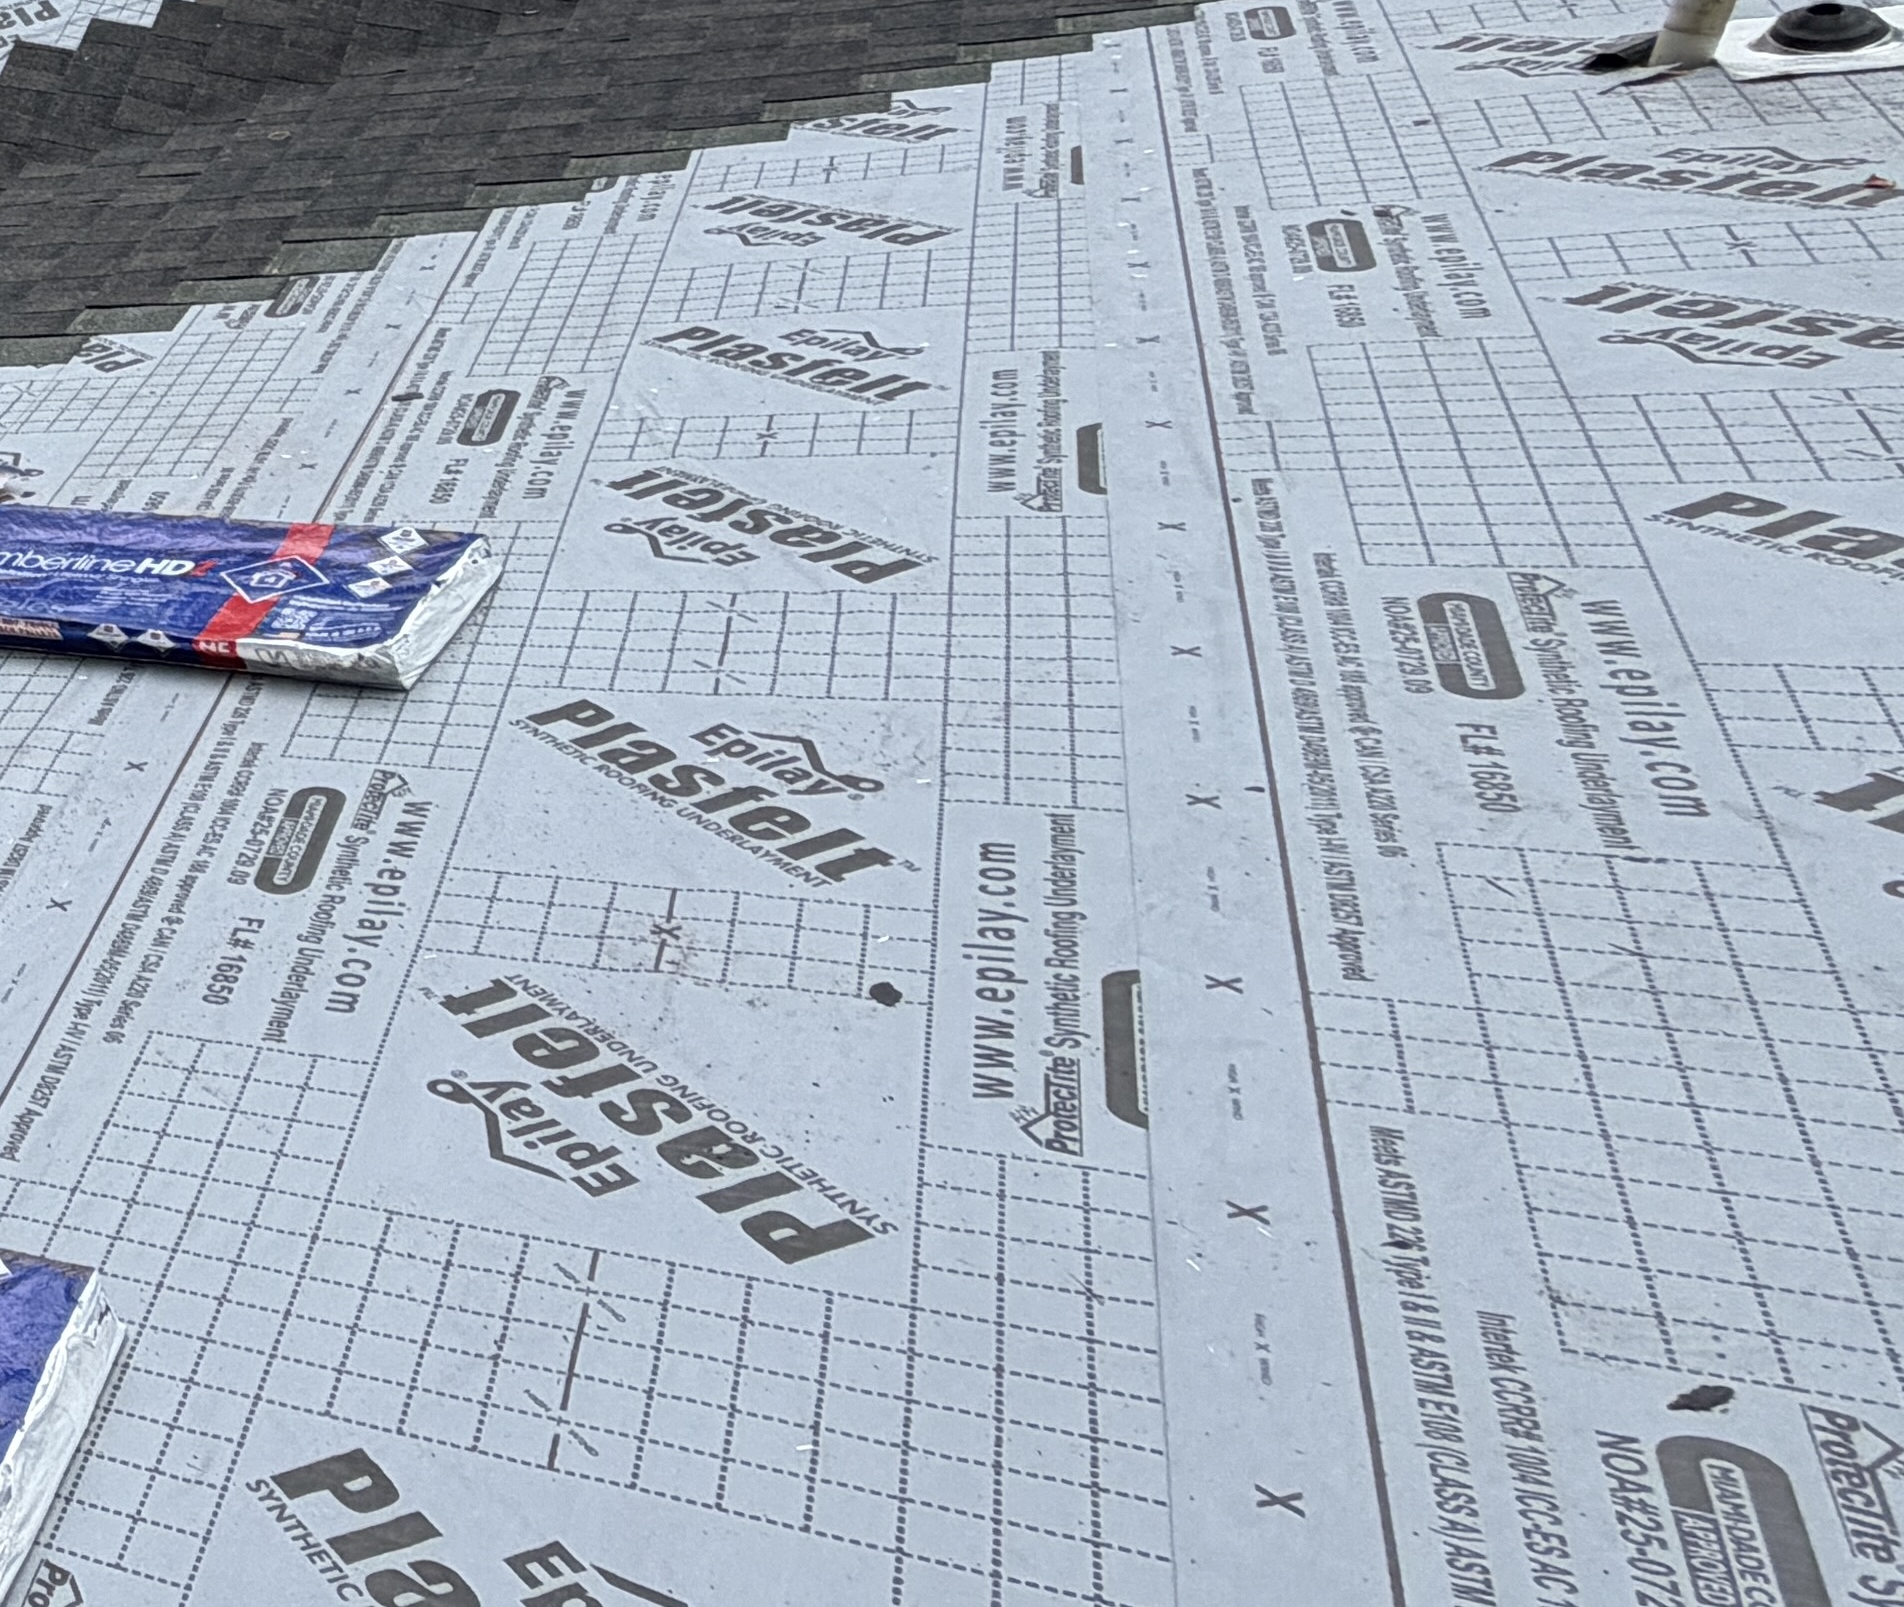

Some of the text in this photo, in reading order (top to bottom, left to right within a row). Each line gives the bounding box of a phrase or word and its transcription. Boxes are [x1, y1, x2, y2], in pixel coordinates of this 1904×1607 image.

[652, 326, 933, 401] Plasfelt
[605, 469, 925, 584] Plasfelt
[1552, 699, 1599, 749] Roofing
[1581, 600, 1710, 817] www.epilay.com
[509, 719, 833, 888] SYNTHETIC ROOFING UNDERLAYMENT
[524, 698, 896, 882] Plasfelt
[689, 723, 849, 796] Epilay
[1571, 753, 1642, 850] Underlayment
[325, 801, 433, 1014] www.epilay.com
[326, 835, 370, 892] Synthetic
[1043, 813, 1084, 906] Underlayment
[202, 917, 265, 1005] FL# 16850
[296, 894, 346, 943] Roofing
[1044, 911, 1087, 969] Roofing
[261, 948, 325, 1044] Underlayment
[962, 842, 1028, 1098] www.epilay.com
[1044, 975, 1091, 1049] Synthetic
[439, 978, 876, 1265] Plasfelt
[465, 1080, 640, 1197] Epilay
[504, 973, 899, 1236] SYNTHETIC ROOFING UNDERLAYMENT
[1410, 1344, 1455, 1399] ASTM
[1417, 1396, 1464, 1443] E108
[1415, 1442, 1479, 1519] (CLASS
[1476, 1310, 1578, 1593] Intertek CCRR# 1004 ICC-ES AC
[246, 1478, 365, 1602] SYNTHETIC
[1680, 1515, 1738, 1607] APPROVED
[1707, 1462, 1772, 1586] MIAMI-DADE
